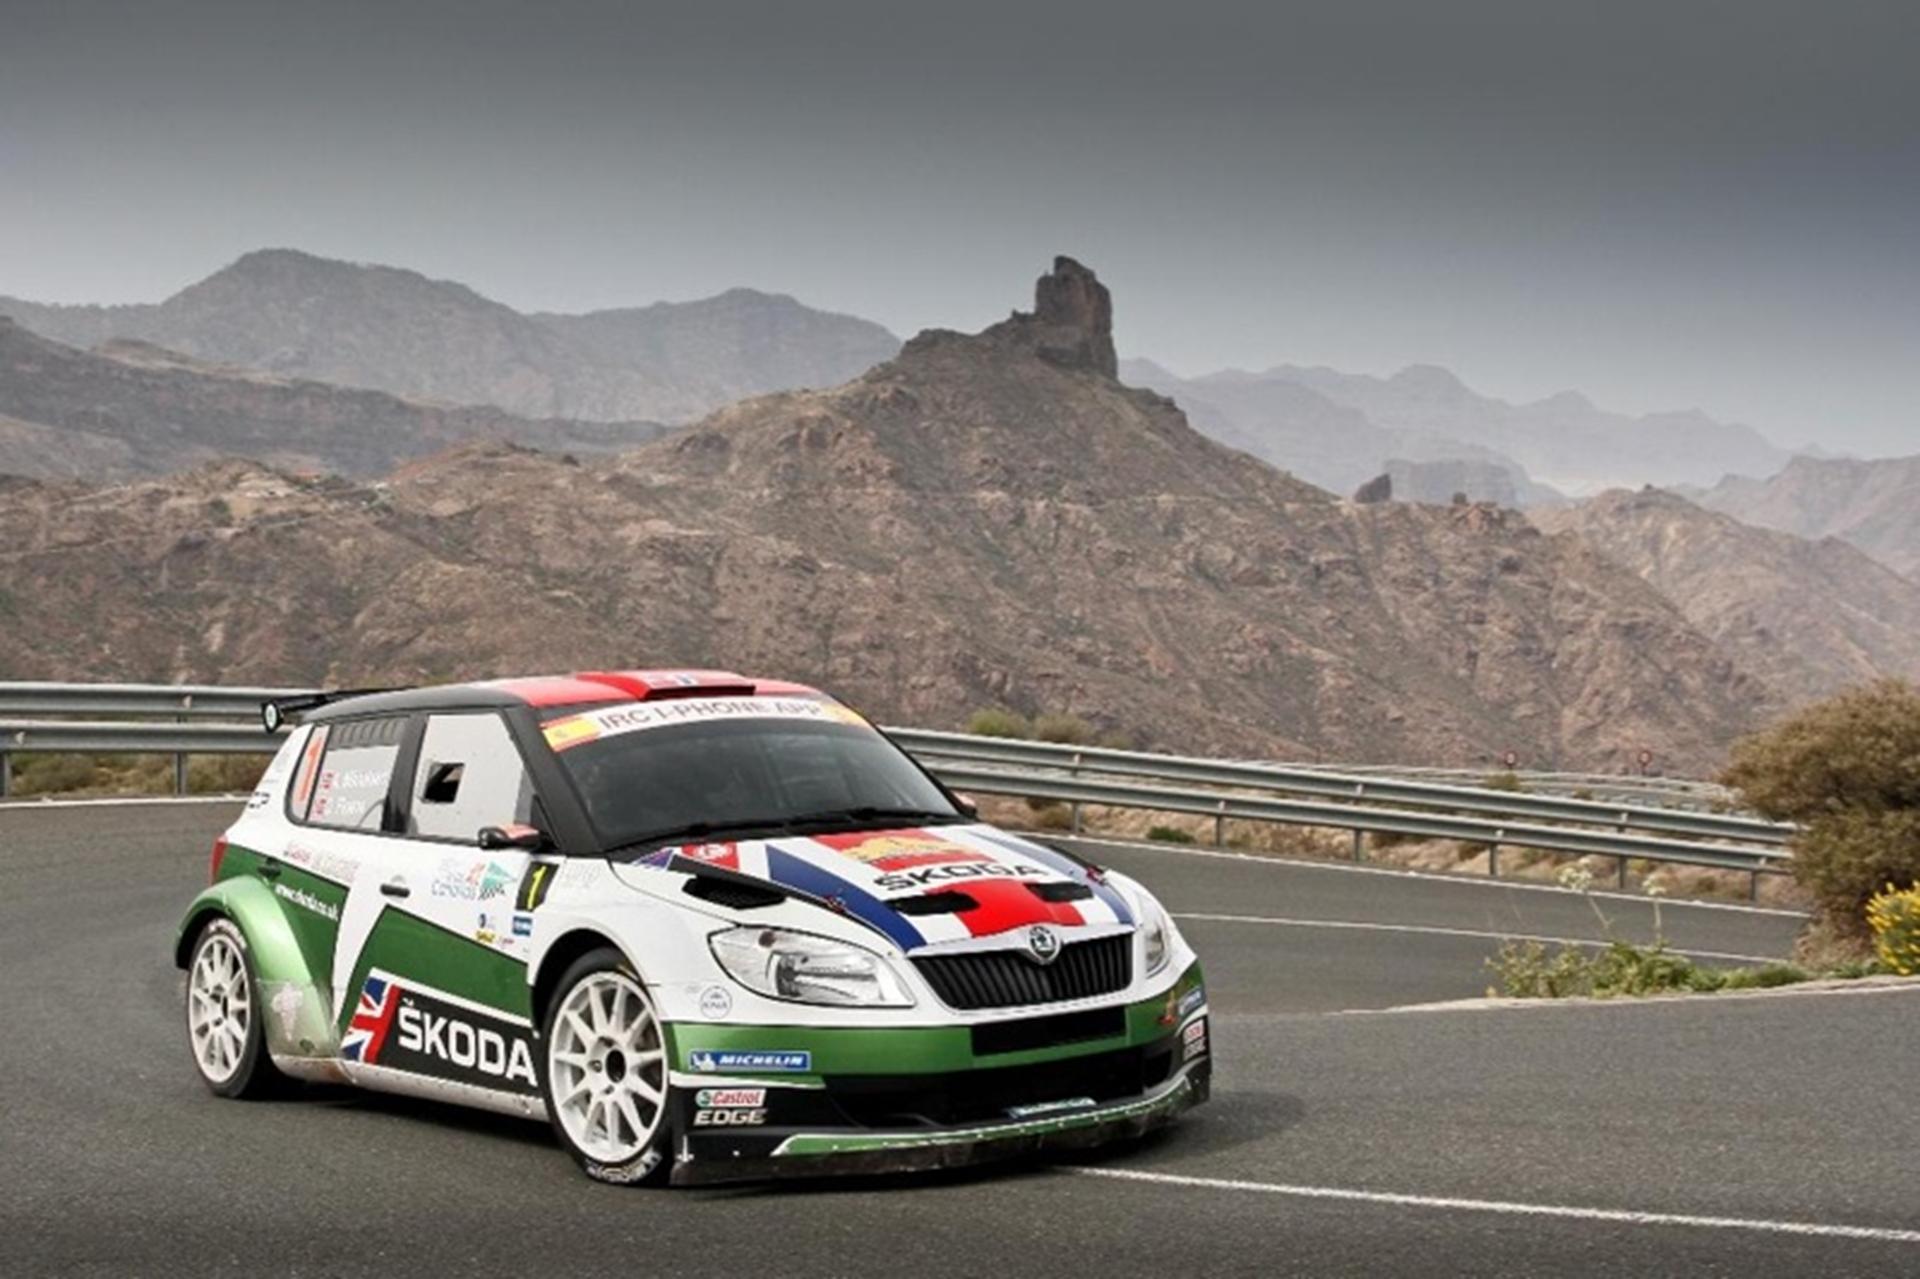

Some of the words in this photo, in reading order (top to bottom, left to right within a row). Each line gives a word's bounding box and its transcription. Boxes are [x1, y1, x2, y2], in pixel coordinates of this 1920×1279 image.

[598, 709, 650, 730] IRC
[655, 701, 766, 719] I-PHONE
[774, 702, 821, 715] APP
[527, 865, 547, 910] 1
[398, 997, 538, 1087] ŠKODA
[718, 1054, 804, 1067] MICHELIN
[712, 1090, 761, 1105] Castrol
[693, 1109, 768, 1126] EDGE
